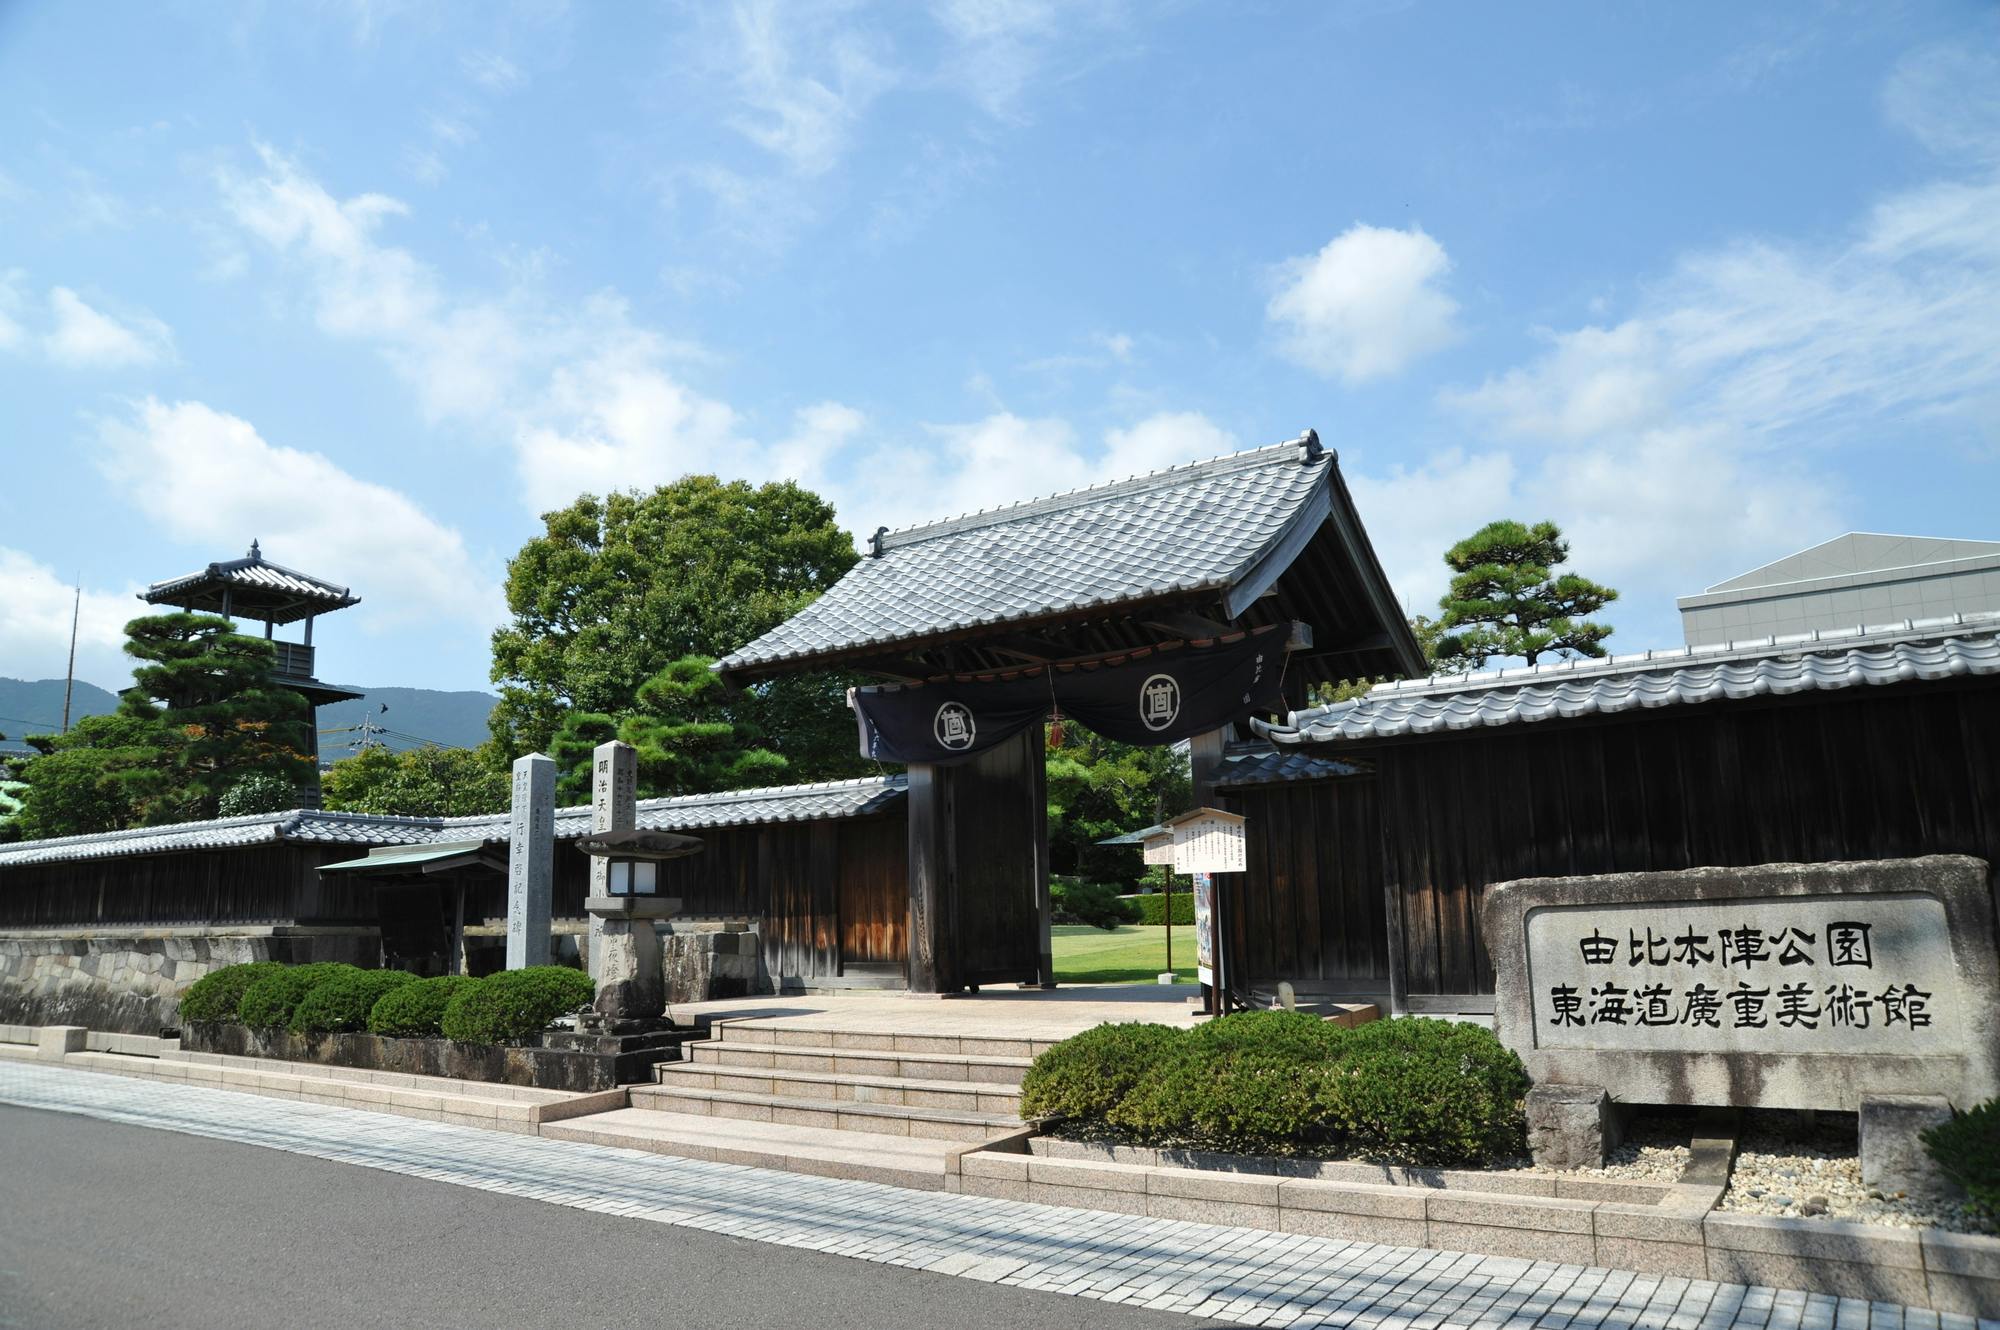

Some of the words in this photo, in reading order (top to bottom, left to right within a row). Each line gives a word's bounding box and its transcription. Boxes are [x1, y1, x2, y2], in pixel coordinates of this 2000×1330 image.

[1580, 922, 1872, 969] 由比本陣公園
[1550, 981, 1932, 1030] 東海道廣重美術館
